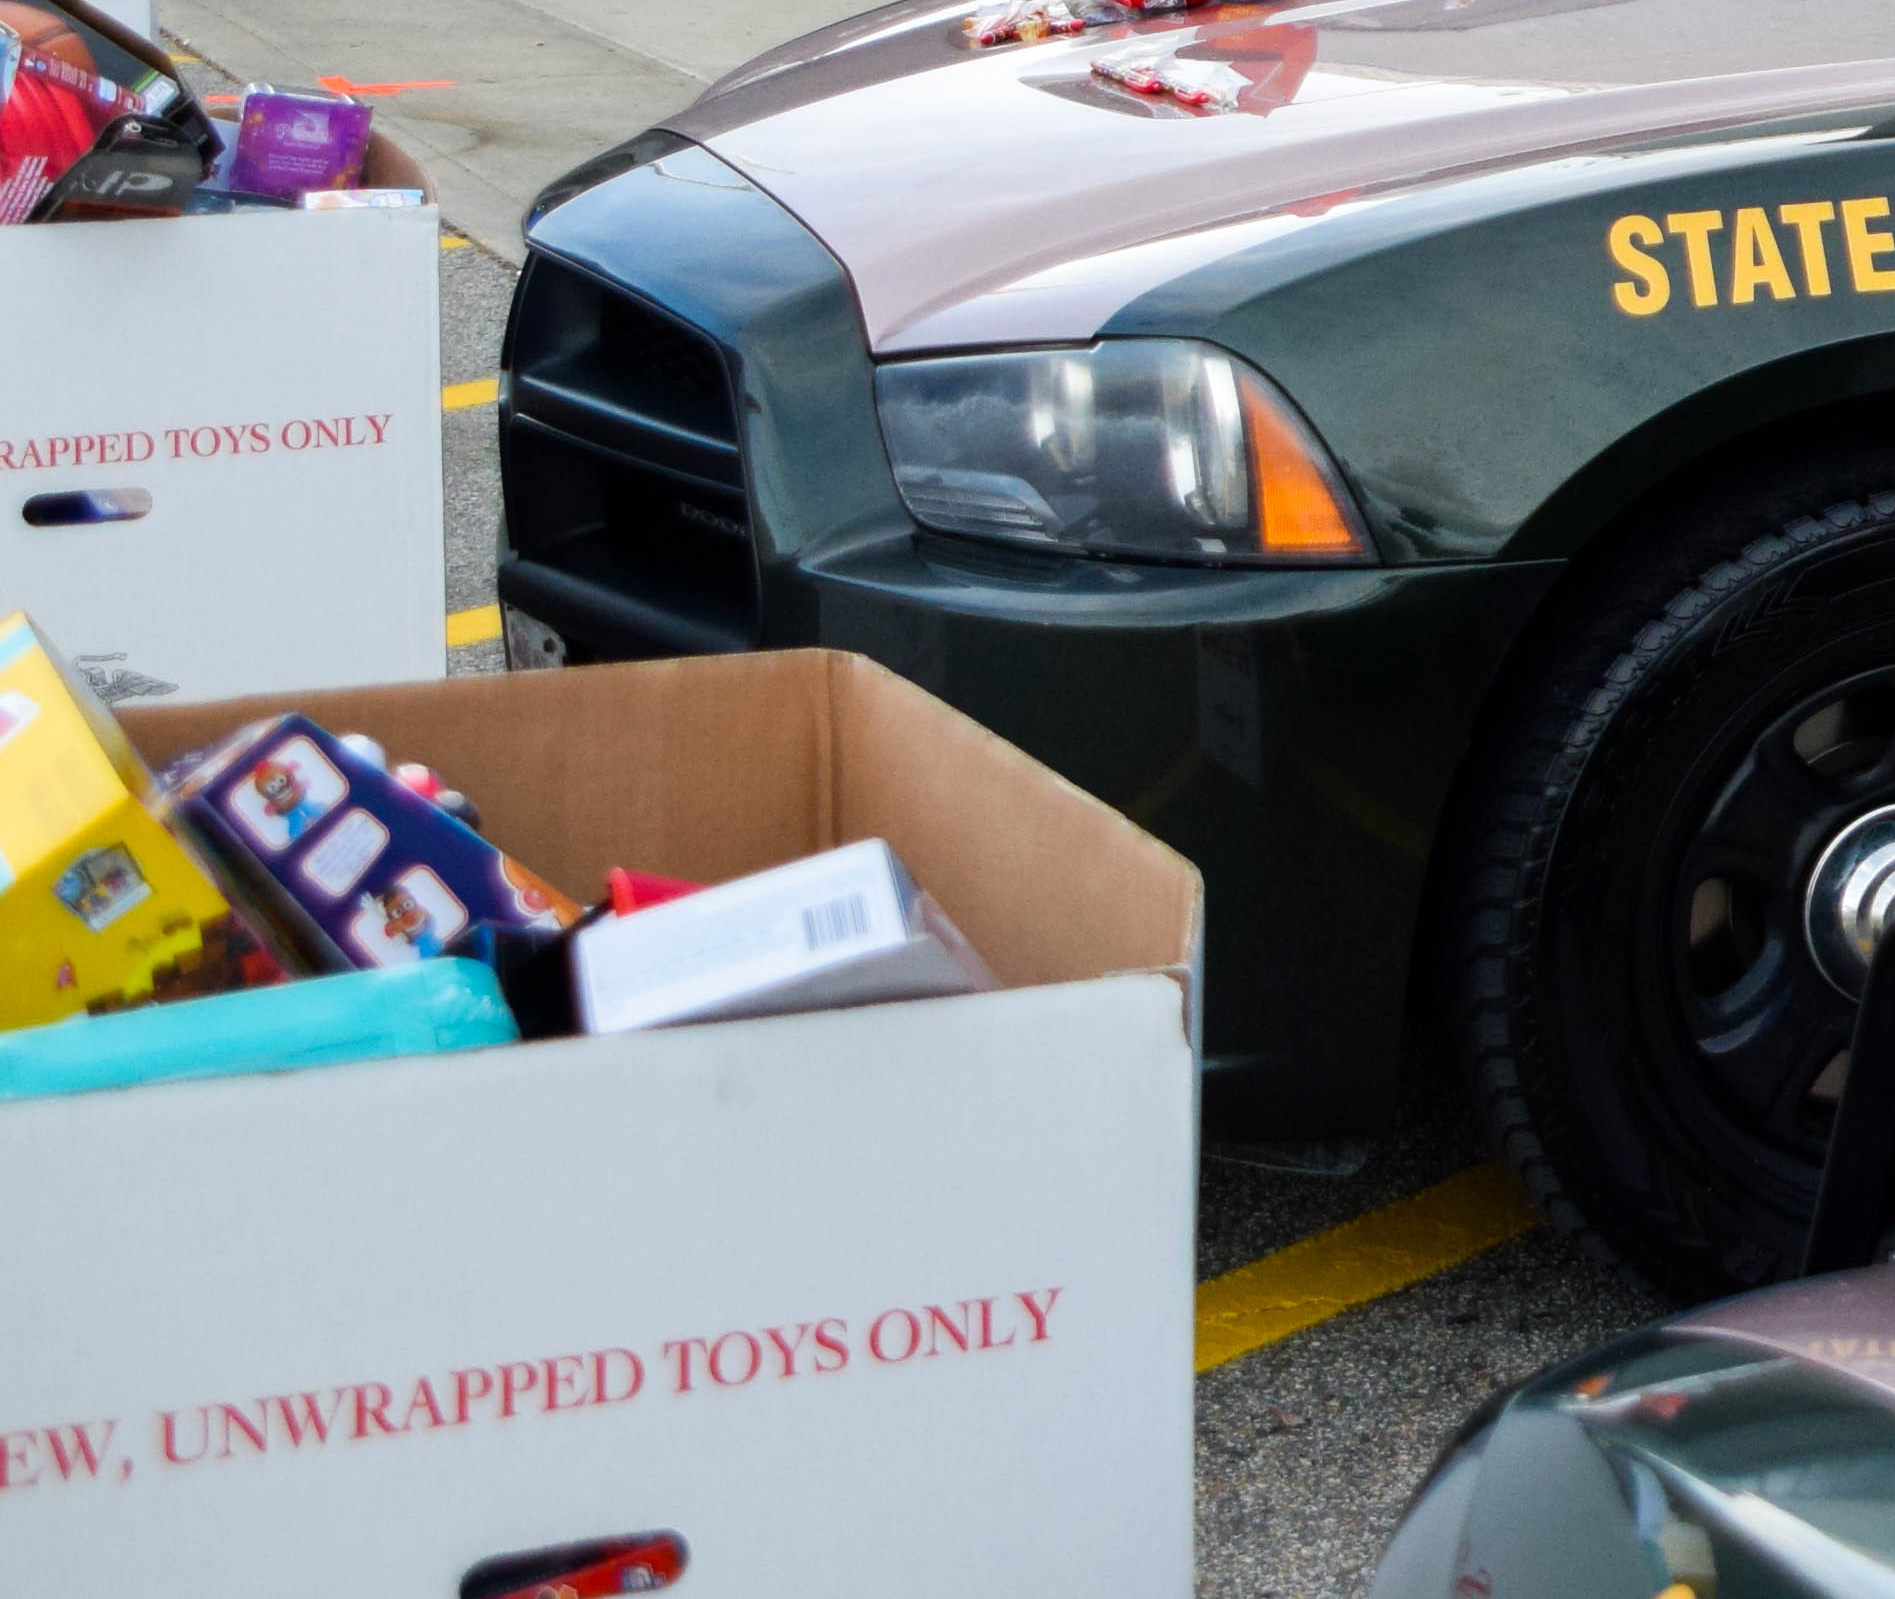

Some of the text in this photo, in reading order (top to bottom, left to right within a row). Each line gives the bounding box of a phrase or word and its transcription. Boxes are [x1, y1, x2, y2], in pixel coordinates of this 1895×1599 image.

[164, 423, 271, 460] TOYS
[280, 414, 393, 451] ONLY
[158, 1348, 646, 1464] UNWRAPPED
[663, 1319, 849, 1395] TOYS
[869, 1287, 1065, 1365] ONLY
